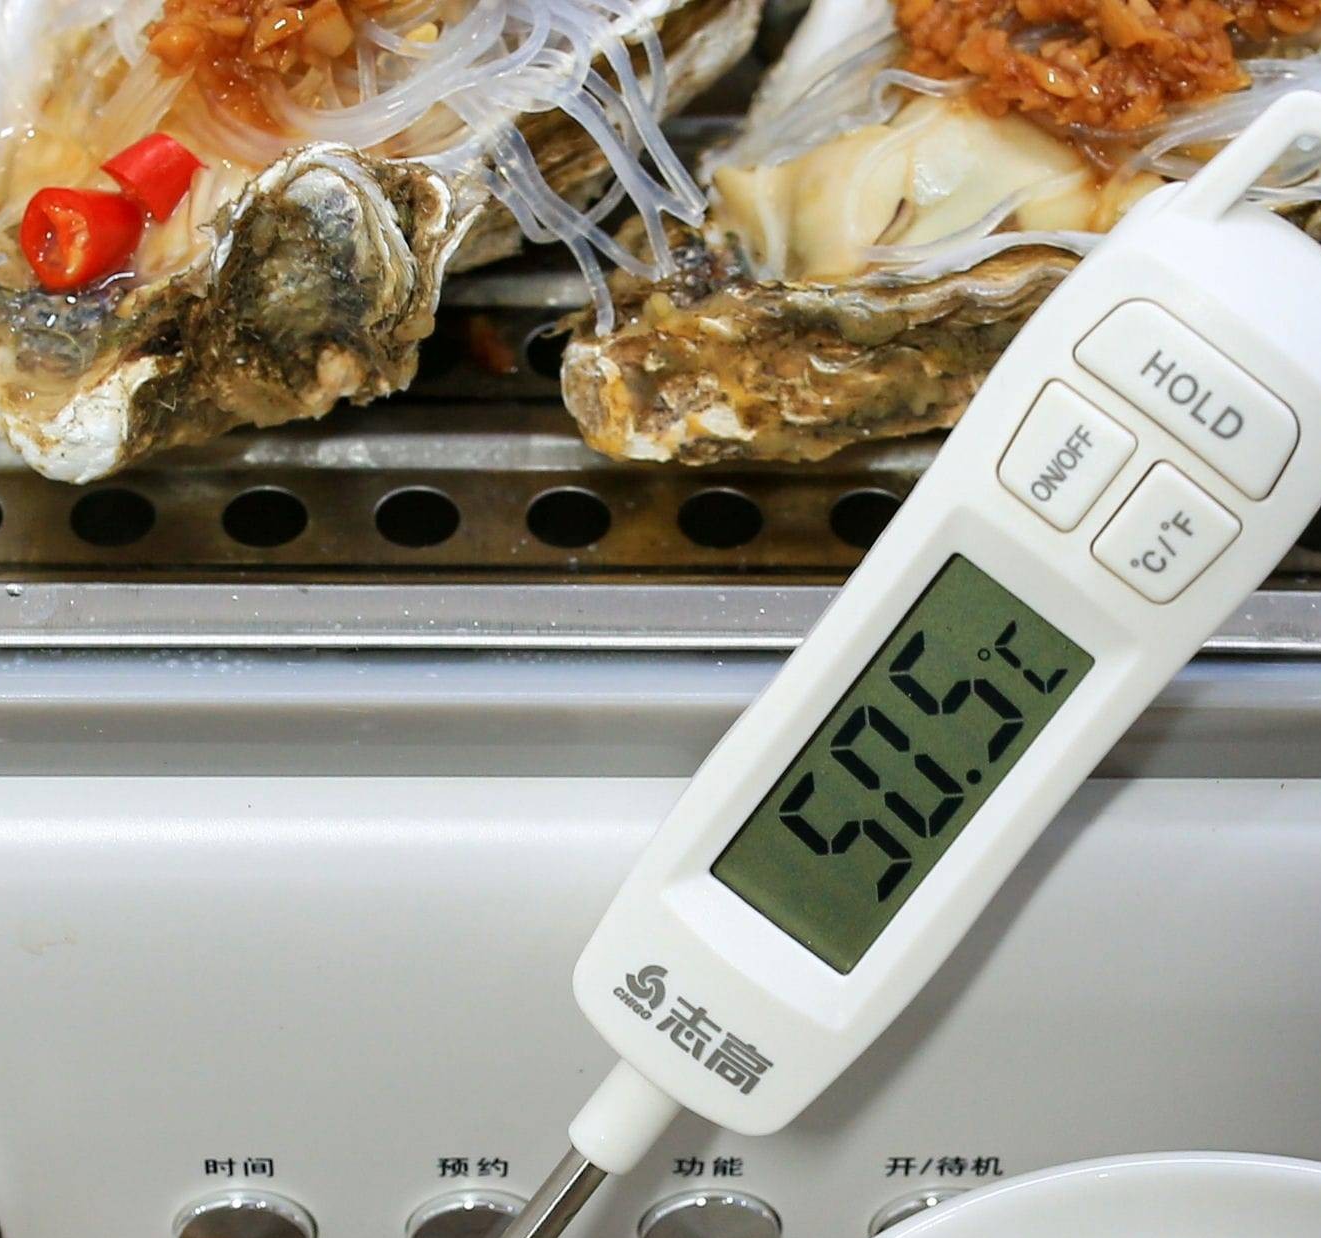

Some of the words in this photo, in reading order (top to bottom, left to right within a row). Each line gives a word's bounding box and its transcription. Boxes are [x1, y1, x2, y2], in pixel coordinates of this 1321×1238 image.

[1140, 349, 1245, 440] HOLD
[1030, 425, 1094, 503] ON/OFF
[655, 995, 774, 1096] 志高
[204, 1157, 275, 1178] 时间
[437, 1157, 509, 1178] 预约
[674, 1157, 744, 1178] 功能
[885, 1157, 1004, 1178] 开/待机
